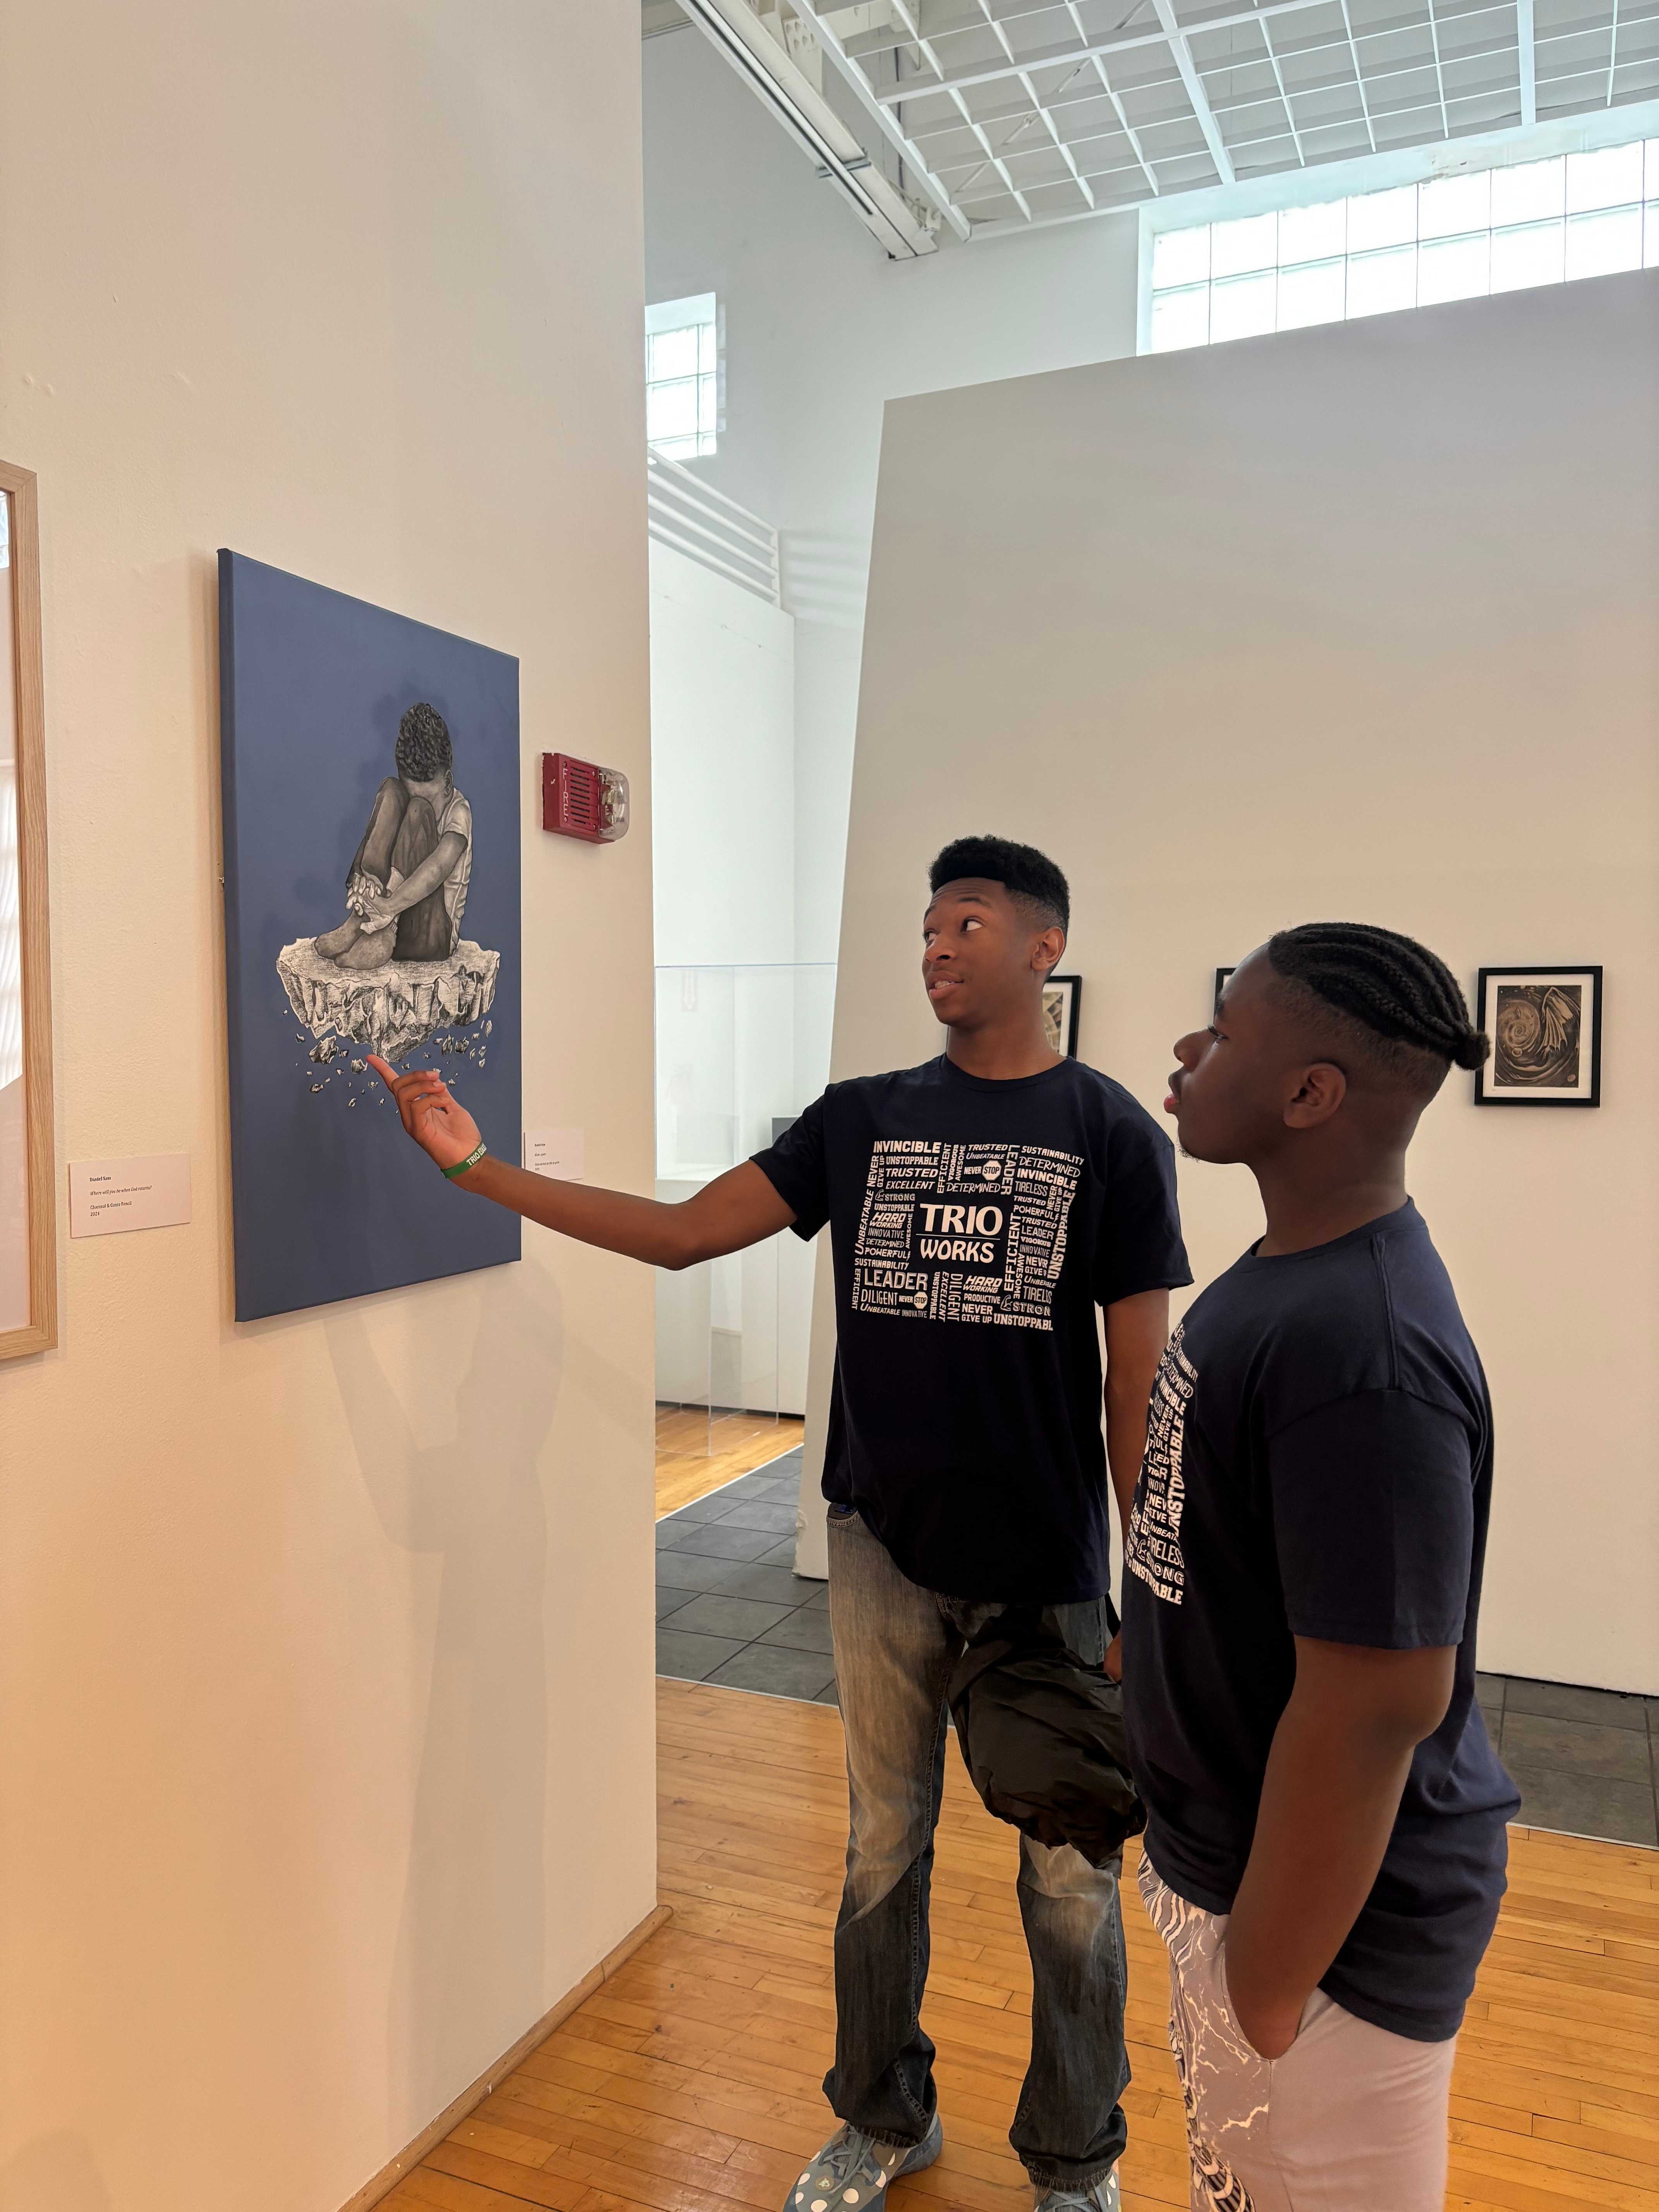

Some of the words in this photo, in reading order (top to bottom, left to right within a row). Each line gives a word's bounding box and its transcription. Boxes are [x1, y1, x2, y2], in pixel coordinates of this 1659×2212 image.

[873, 1140, 942, 1154] INVINCIBLE
[466, 1152, 480, 1166] TRIO
[879, 1155, 884, 1165] UP
[886, 1156, 939, 1166] UNSTOPPABLE
[948, 1144, 959, 1181] VIGOROUS
[1021, 1146, 1084, 1165] SUSTAINABILITY
[937, 1143, 951, 1194] EFFICIENT
[955, 1145, 966, 1181] AWESOME
[1001, 1145, 1020, 1195] LEADER
[1019, 1156, 1081, 1178] DETERMINED
[867, 1155, 879, 1187] NEVER
[886, 1168, 938, 1177] TRUSTED
[964, 1166, 982, 1175] NEVER
[886, 1181, 936, 1190] EXCELLENT
[1017, 1168, 1077, 1190] INVINCIBLE
[946, 1182, 1001, 1194] DETERMINED
[1015, 1181, 1048, 1196] TIRELESS
[1057, 1187, 1063, 1195] UP
[885, 1193, 916, 1201] STRONG
[1013, 1195, 1046, 1206] TRUSTED
[1046, 1185, 1058, 1210] NEVER
[1054, 1196, 1062, 1212] GIVE
[874, 1203, 915, 1211] UNSTOPPABLE
[1013, 1205, 1054, 1220] POWERFUL
[869, 1220, 903, 1228] WORKING
[872, 1212, 906, 1222] HARD
[920, 1203, 1003, 1236] TRIO
[1022, 1216, 1057, 1229] TRUSTED
[1022, 1225, 1054, 1240] LEADER
[1047, 1190, 1076, 1279] UNSTOPPABLE
[866, 1238, 905, 1248] DETERMINED
[865, 1247, 907, 1259] POWERFUL
[921, 1239, 994, 1263] WORKS
[1004, 1212, 1021, 1291] EFFICIENT
[854, 1258, 909, 1270] SUSTAINABILITY
[1025, 1266, 1042, 1276] GIVE
[864, 1268, 929, 1290] LEADER
[965, 1275, 1003, 1287] HARD
[1013, 1253, 1025, 1299] AWESOME
[852, 1268, 861, 1310] EFFICIENT
[929, 1271, 940, 1319] UNSTOPPABLE
[963, 1284, 999, 1293] WORKING
[861, 1289, 898, 1305] DILIGENT
[899, 1295, 913, 1303] NEVER
[938, 1271, 949, 1322] EXCELLENT
[947, 1273, 963, 1321] DILIGENT
[964, 1293, 1001, 1304] PRODUCTIVE
[962, 1303, 993, 1315] NEVER
[962, 1314, 980, 1322] GIVE
[1168, 1408, 1173, 1420] UP
[1158, 1405, 1170, 1438] NEVER
